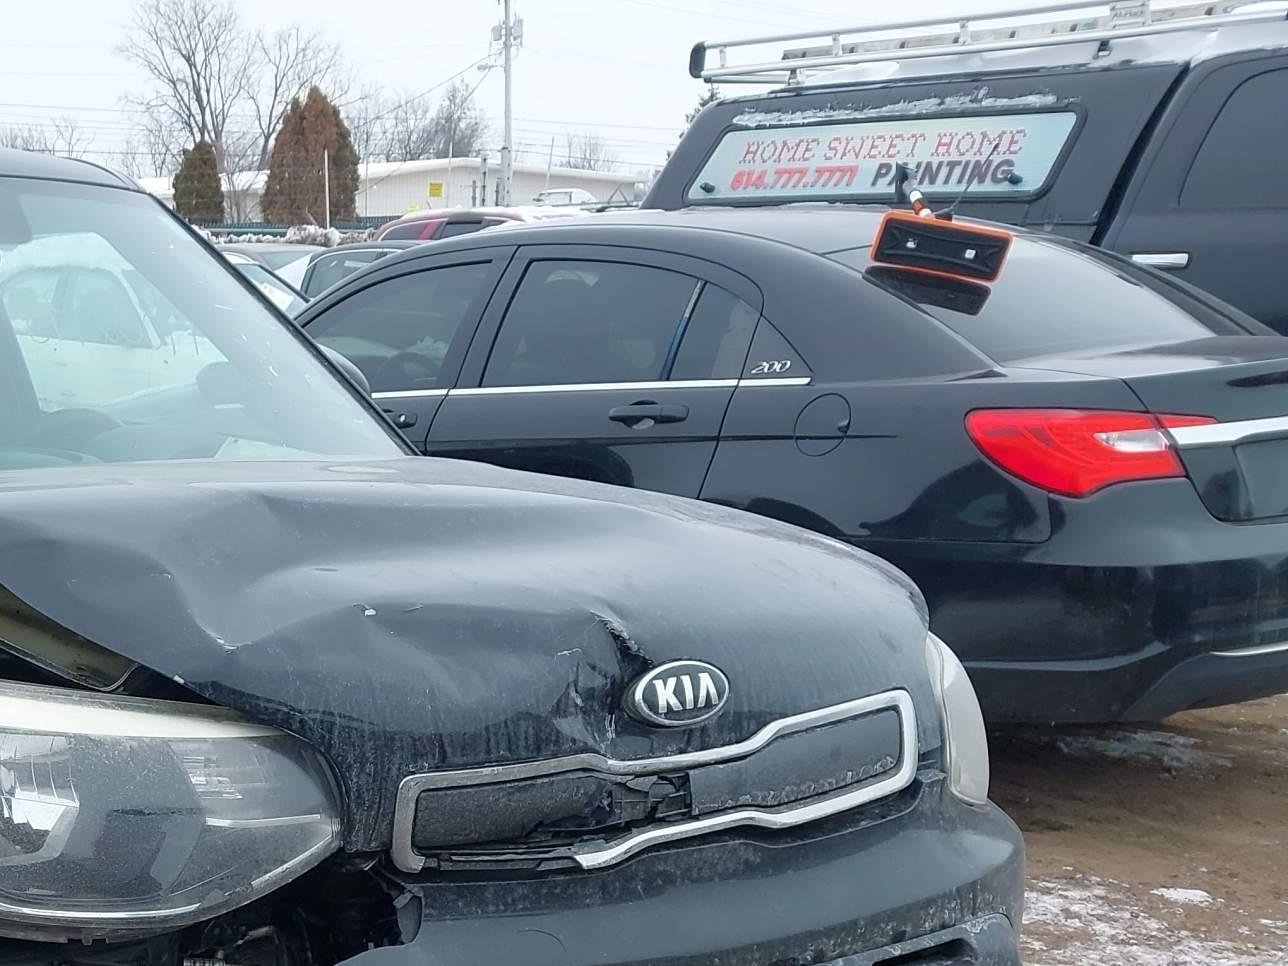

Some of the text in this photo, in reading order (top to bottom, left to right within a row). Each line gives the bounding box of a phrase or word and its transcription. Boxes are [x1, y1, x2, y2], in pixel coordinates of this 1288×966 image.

[739, 129, 1027, 164] HOME SWEET HOME
[751, 360, 791, 374] 200
[652, 672, 719, 714] KIA
